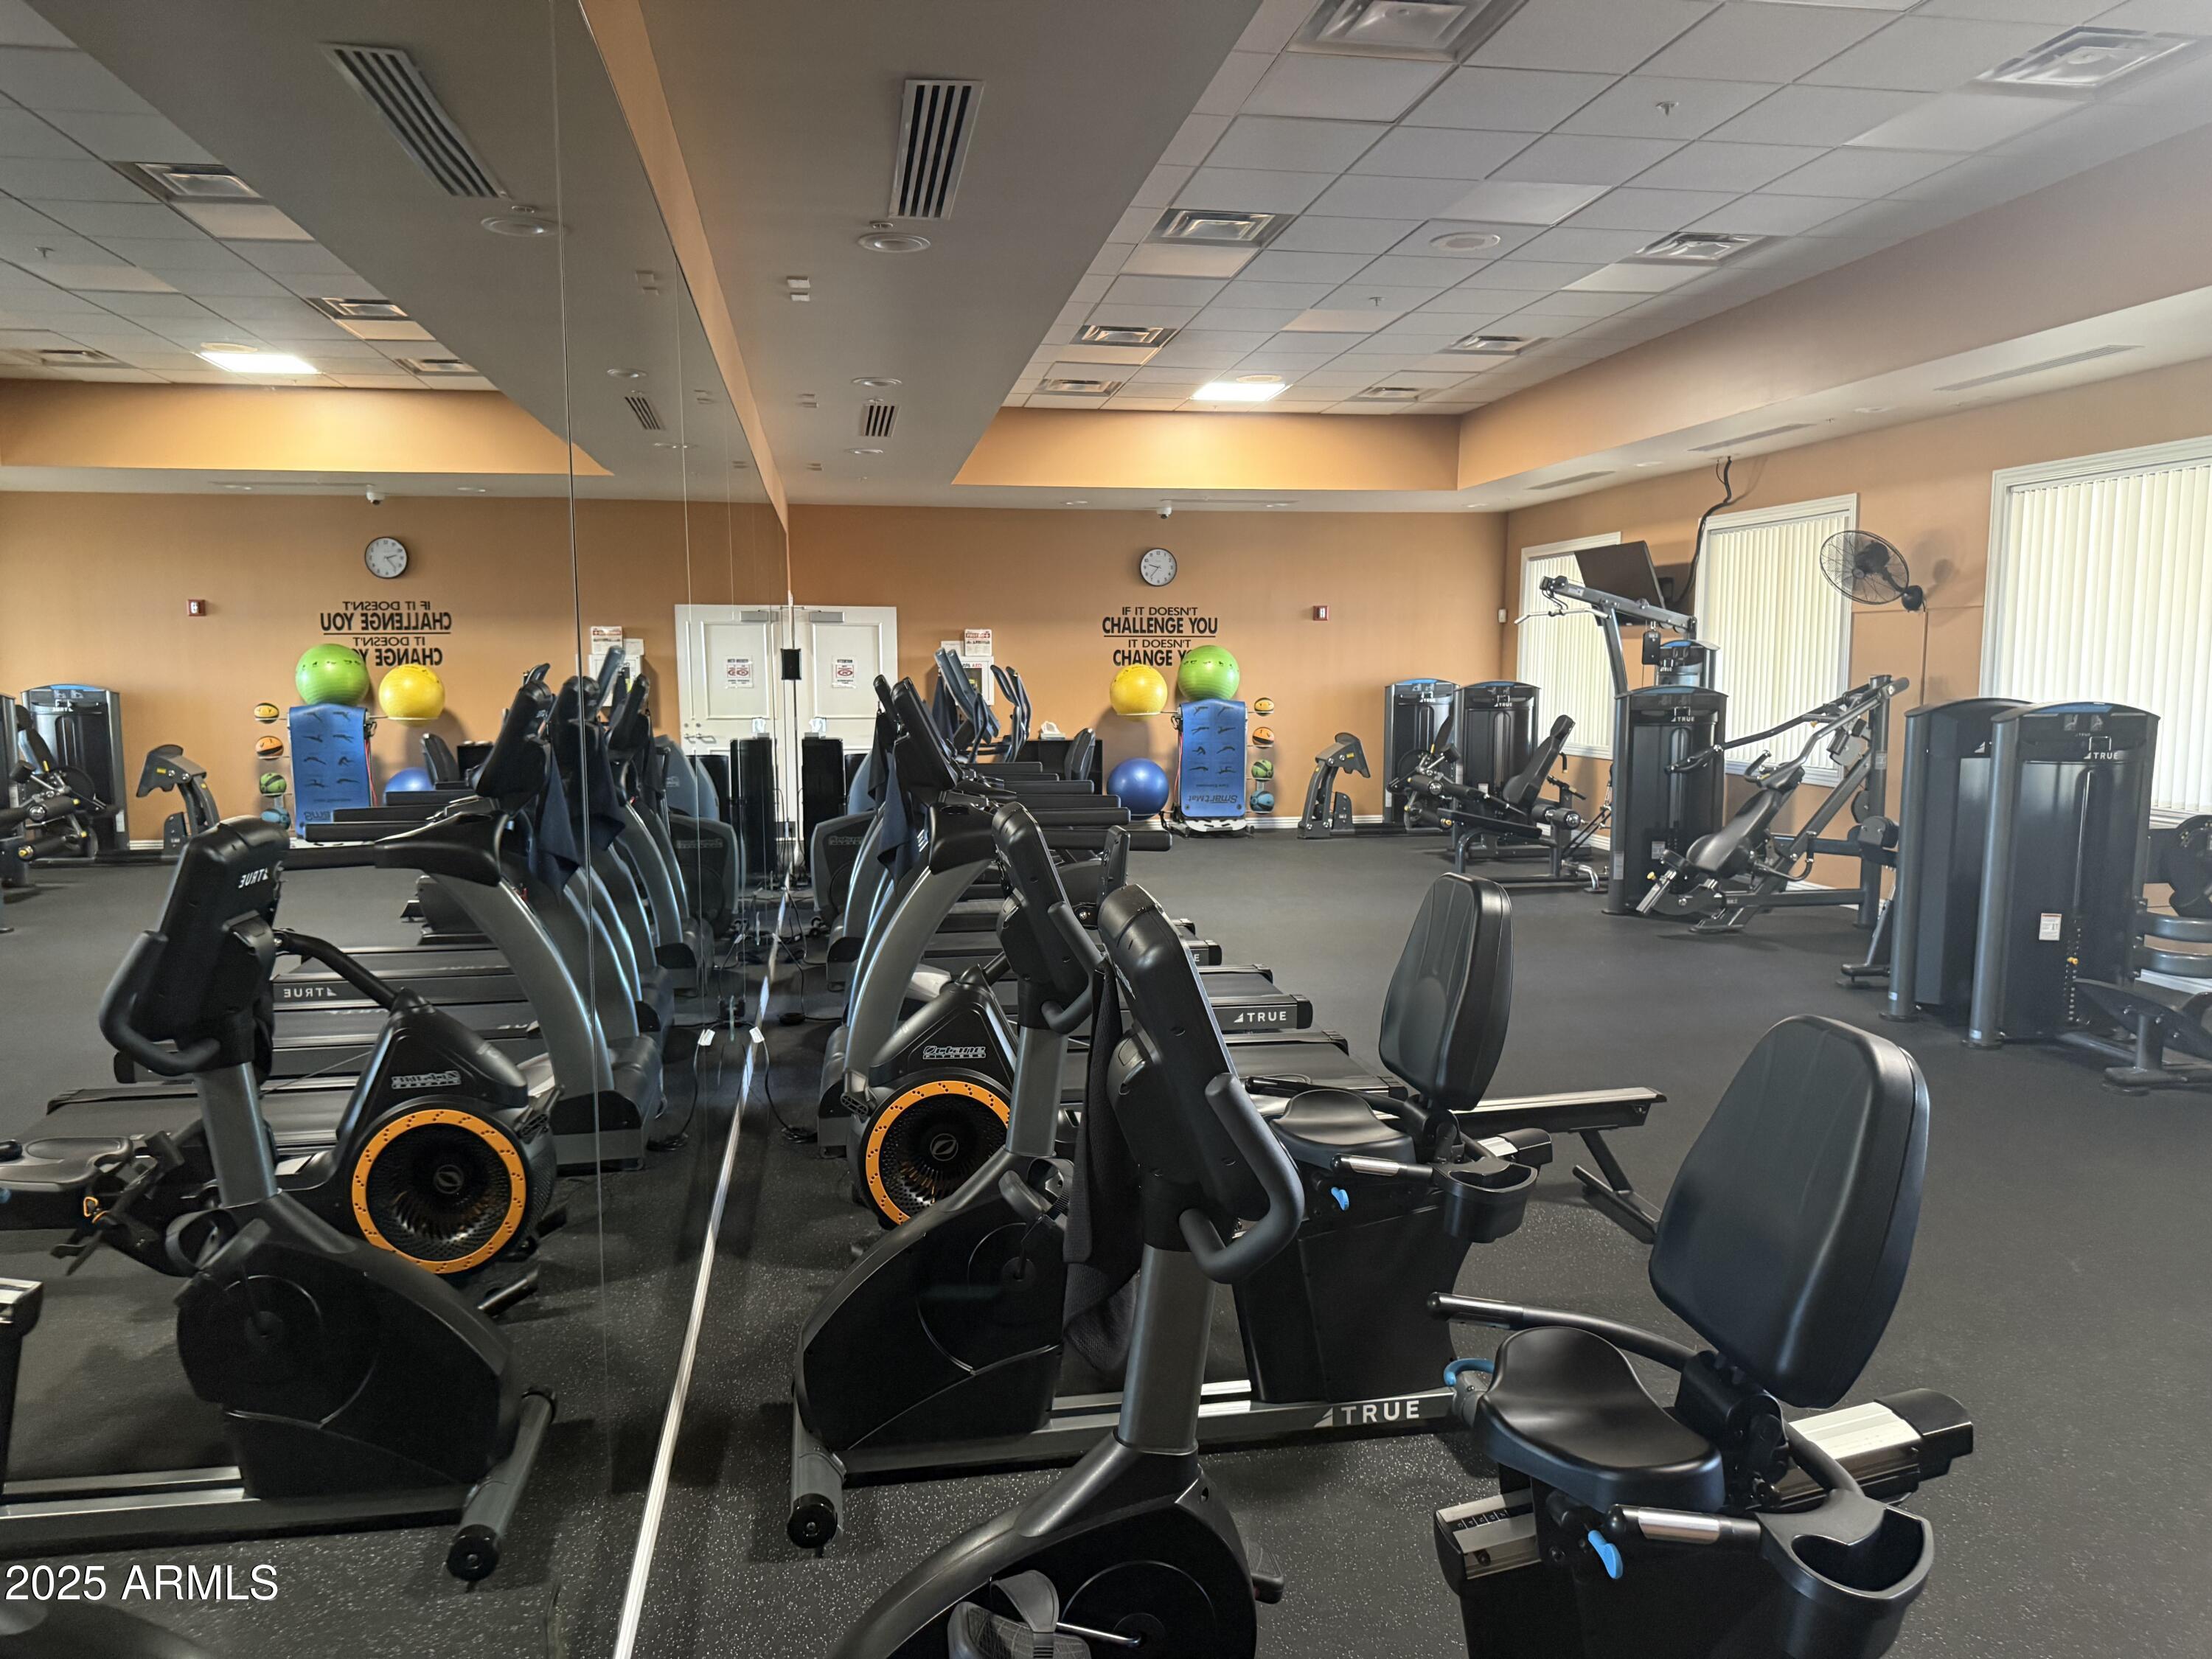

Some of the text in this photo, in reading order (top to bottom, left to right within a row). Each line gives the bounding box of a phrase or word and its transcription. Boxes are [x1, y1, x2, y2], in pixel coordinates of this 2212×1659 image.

[1121, 607, 1197, 616] IF IT DOESN'T
[1102, 616, 1218, 634] CHALLENGE YOU
[1128, 639, 1191, 648] IT DOESN'T
[1113, 649, 1172, 667] CHANGE
[1247, 1011, 1287, 1023] TRUE
[1340, 1400, 1419, 1425] TRUE
